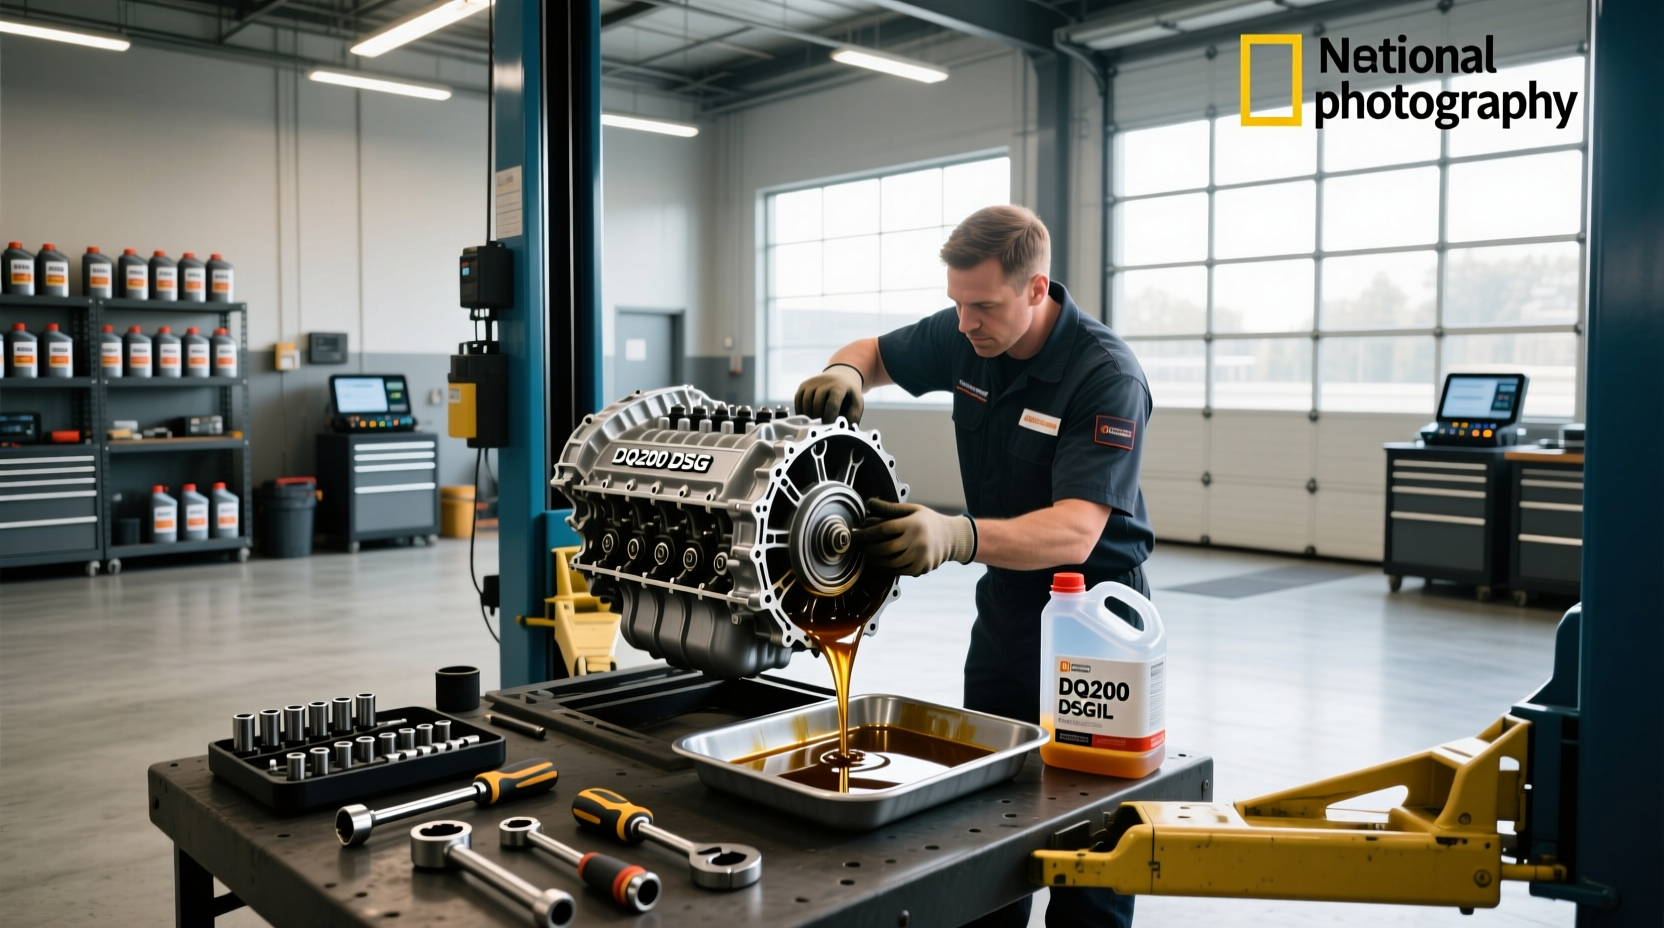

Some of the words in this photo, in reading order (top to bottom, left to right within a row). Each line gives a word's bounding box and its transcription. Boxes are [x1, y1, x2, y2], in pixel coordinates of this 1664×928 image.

[612, 447, 670, 469] DQ200
[667, 452, 713, 473] DSG
[1059, 677, 1130, 702] DQ200
[1058, 698, 1114, 720] DSGIL
